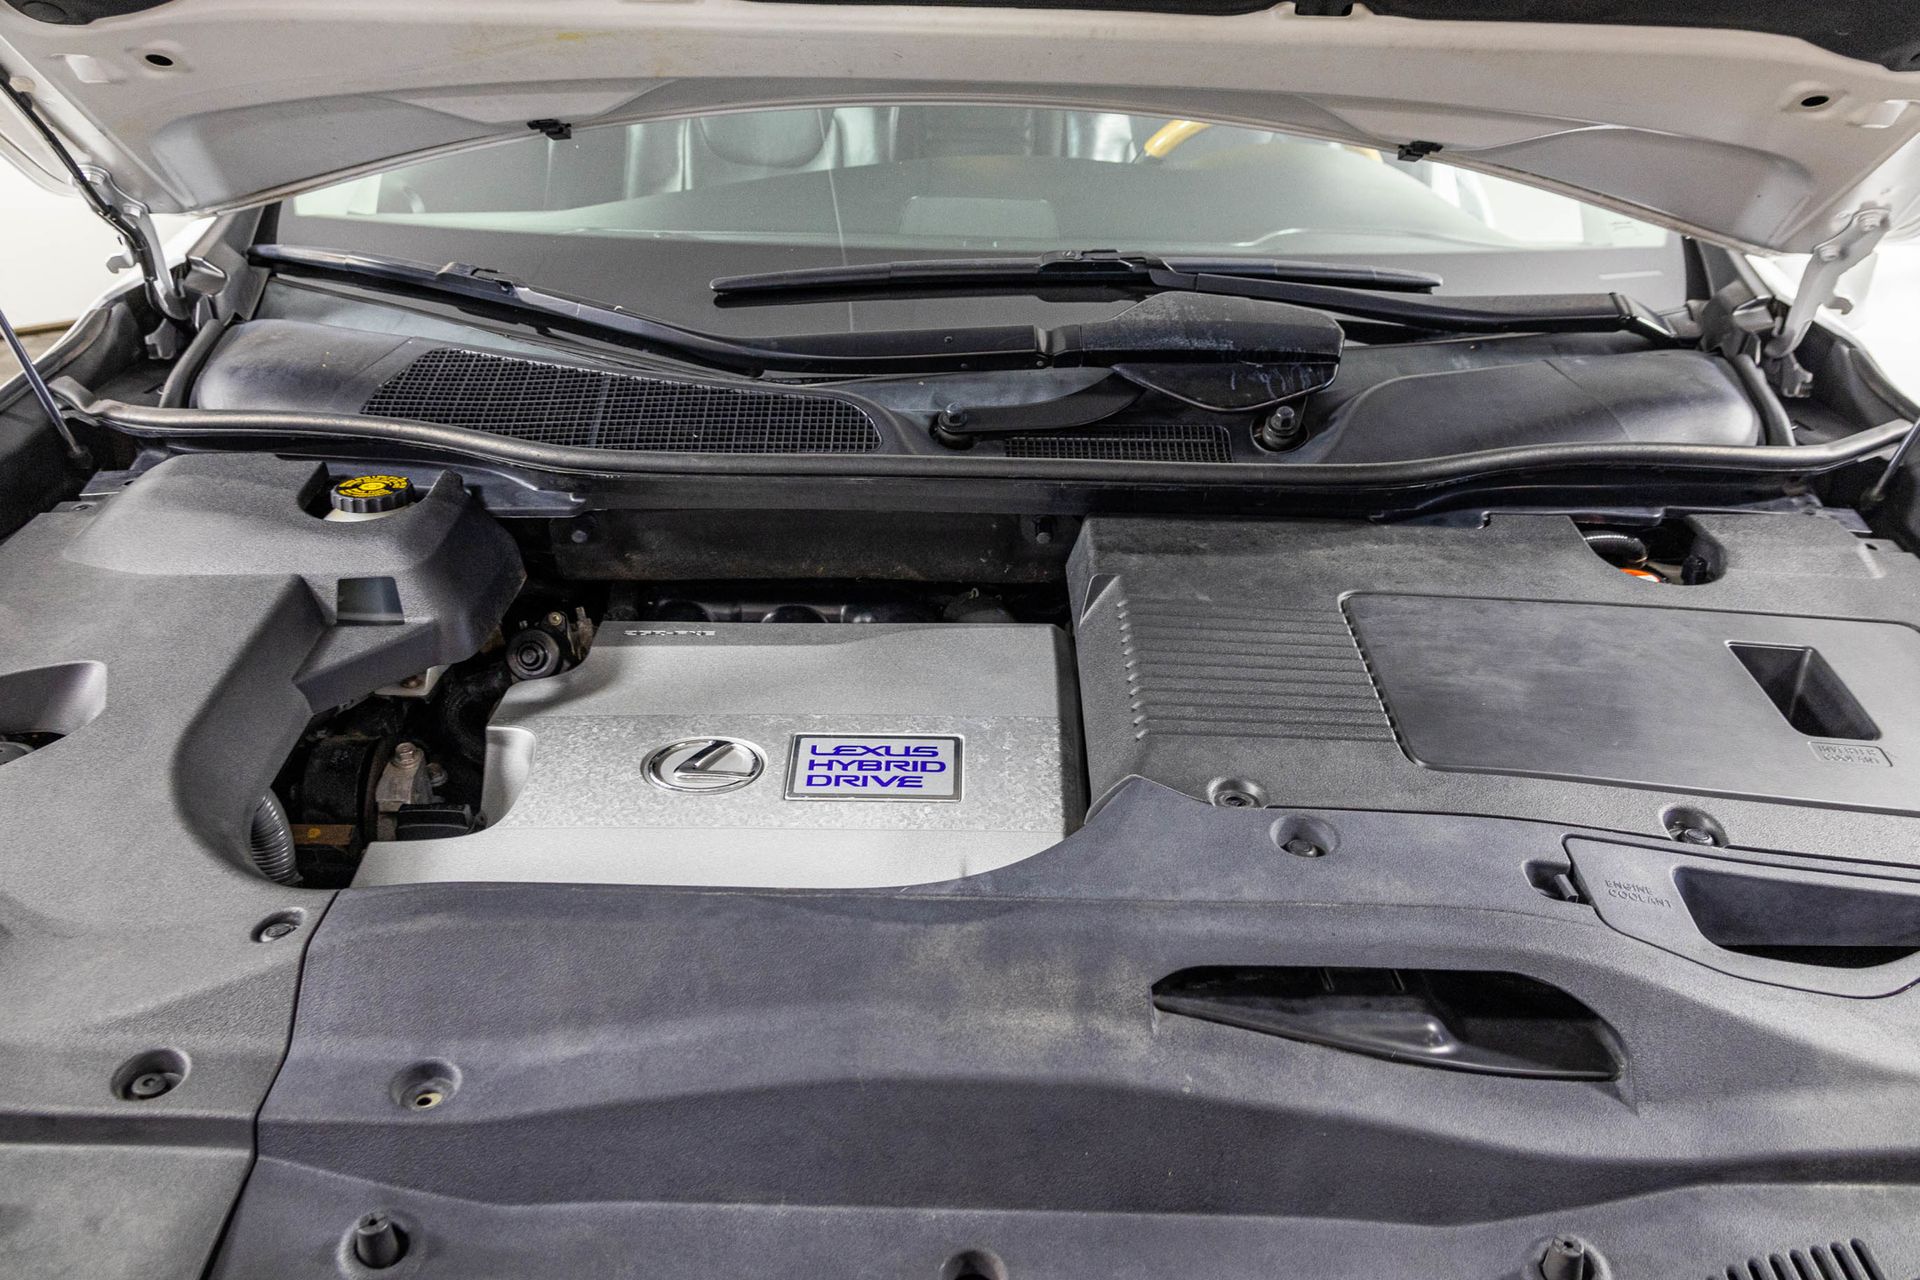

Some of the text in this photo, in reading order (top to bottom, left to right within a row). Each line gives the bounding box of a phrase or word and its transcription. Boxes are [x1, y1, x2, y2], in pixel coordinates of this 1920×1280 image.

[810, 744, 940, 758] LEXUS
[807, 759, 947, 773] HYBRID
[806, 774, 924, 788] DRIVE
[1604, 879, 1653, 896] ENGINE
[1608, 888, 1671, 909] COOLANT
